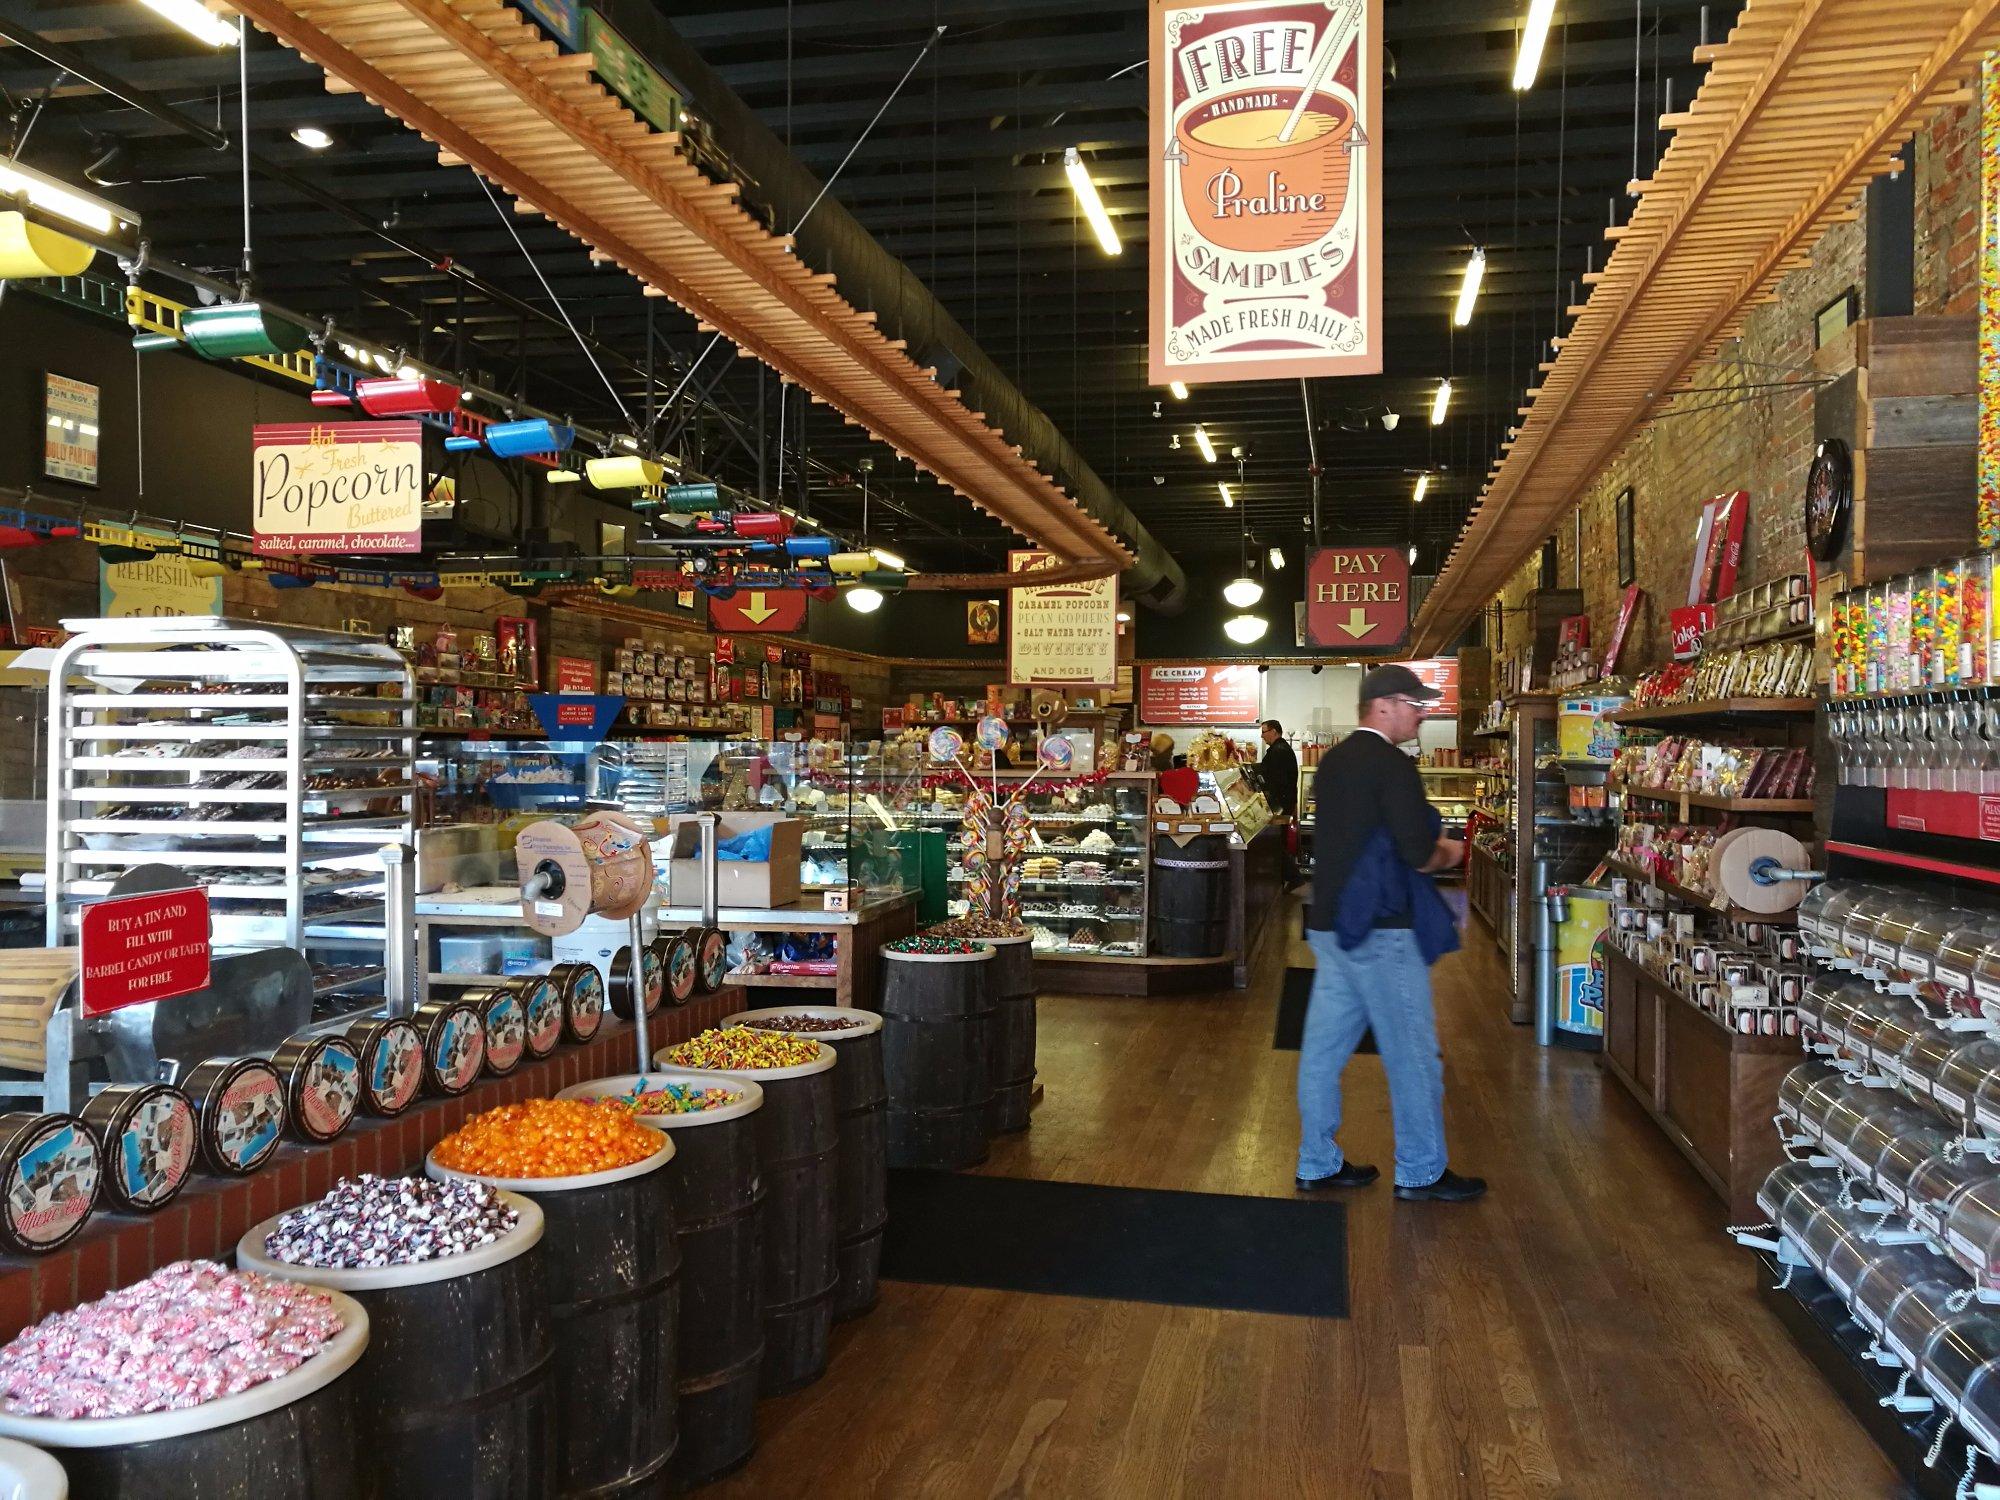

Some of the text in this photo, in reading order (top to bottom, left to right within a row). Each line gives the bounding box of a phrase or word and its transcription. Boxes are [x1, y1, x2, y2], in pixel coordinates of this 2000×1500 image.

[1186, 28, 1307, 93] FREE
[1212, 94, 1279, 117] HANDMADE
[1206, 166, 1326, 219] Praline
[1185, 241, 1344, 288] SAMPLES
[1185, 309, 1347, 350] MADE FRESH DAILY
[303, 424, 337, 453] Hot
[321, 441, 367, 475] Fresh
[259, 453, 419, 527] Popcorn
[347, 491, 413, 529] Buttered
[259, 534, 415, 551] salted, caramel, chocolate...
[1333, 555, 1386, 574] PAY
[1018, 600, 1109, 610] CARAMEL POPCORN
[1316, 582, 1401, 603] HERE
[1018, 612, 1110, 624] PECAN GOPHERS
[1024, 628, 1103, 637] SALT WATER TAFFY
[1672, 624, 1696, 650] Coke
[1033, 667, 1094, 676] AND MORE!
[108, 905, 187, 932] BUY A TIN AND
[126, 929, 172, 949] FILL WITH
[86, 942, 207, 979] BARREL CANDY OR TAFFY
[128, 970, 173, 991] FOR FREE
[17, 1205, 58, 1235] Music
